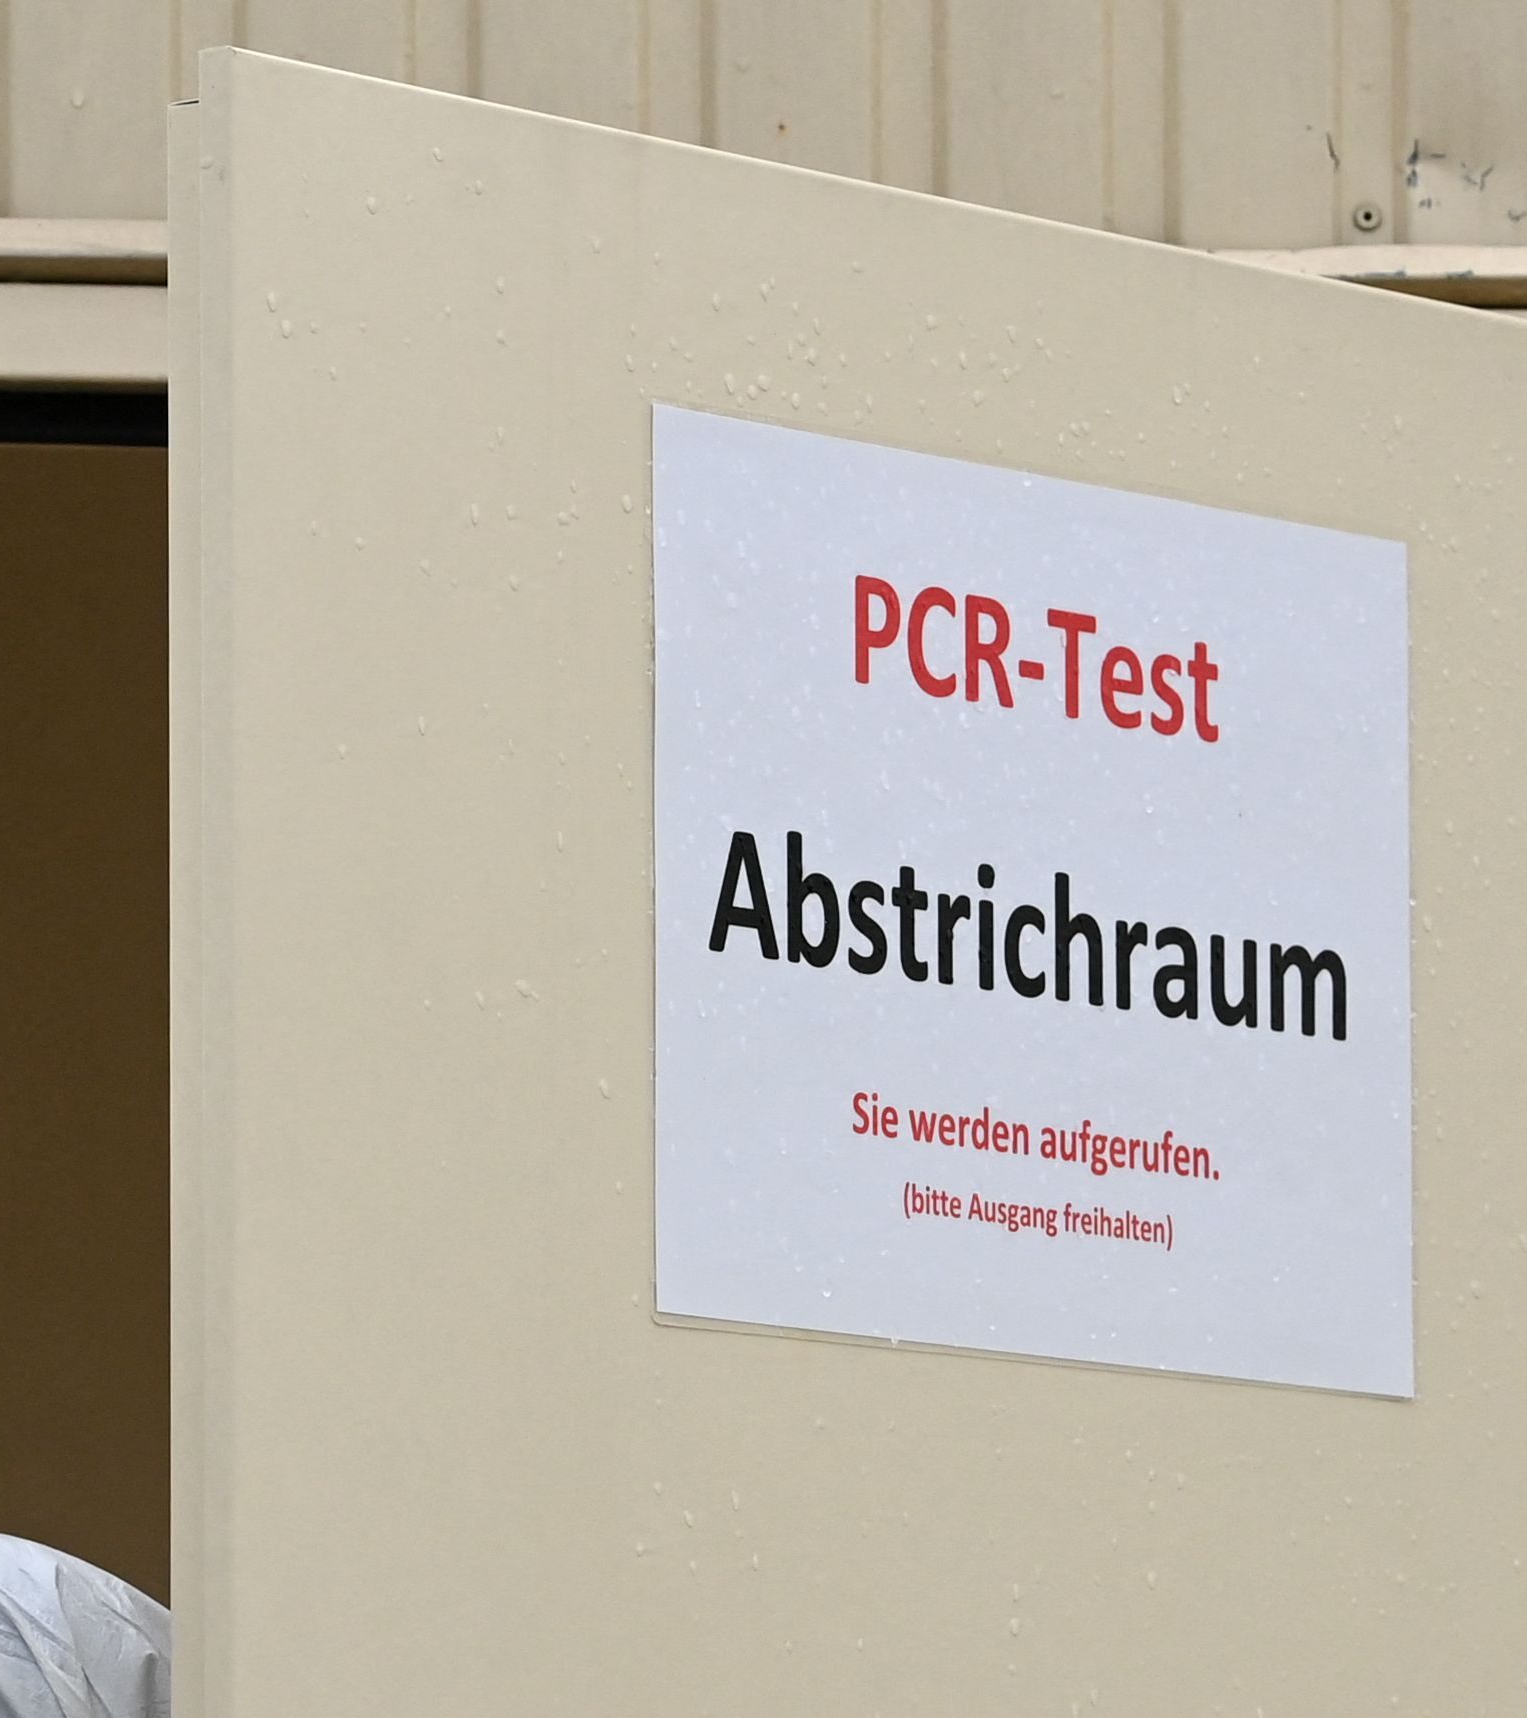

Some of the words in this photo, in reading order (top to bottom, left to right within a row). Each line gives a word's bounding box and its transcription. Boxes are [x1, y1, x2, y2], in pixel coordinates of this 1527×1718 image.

[854, 574, 1219, 744] PCR-Test
[708, 830, 1348, 1042] Abstrichraum
[852, 1091, 899, 1139] Sie
[908, 1106, 1030, 1156] werden
[1039, 1119, 1220, 1181] aufgerufen.
[903, 1181, 962, 1220] (bitte
[967, 1193, 1058, 1238] Ausgang
[1062, 1202, 1173, 1252] freihalten)
